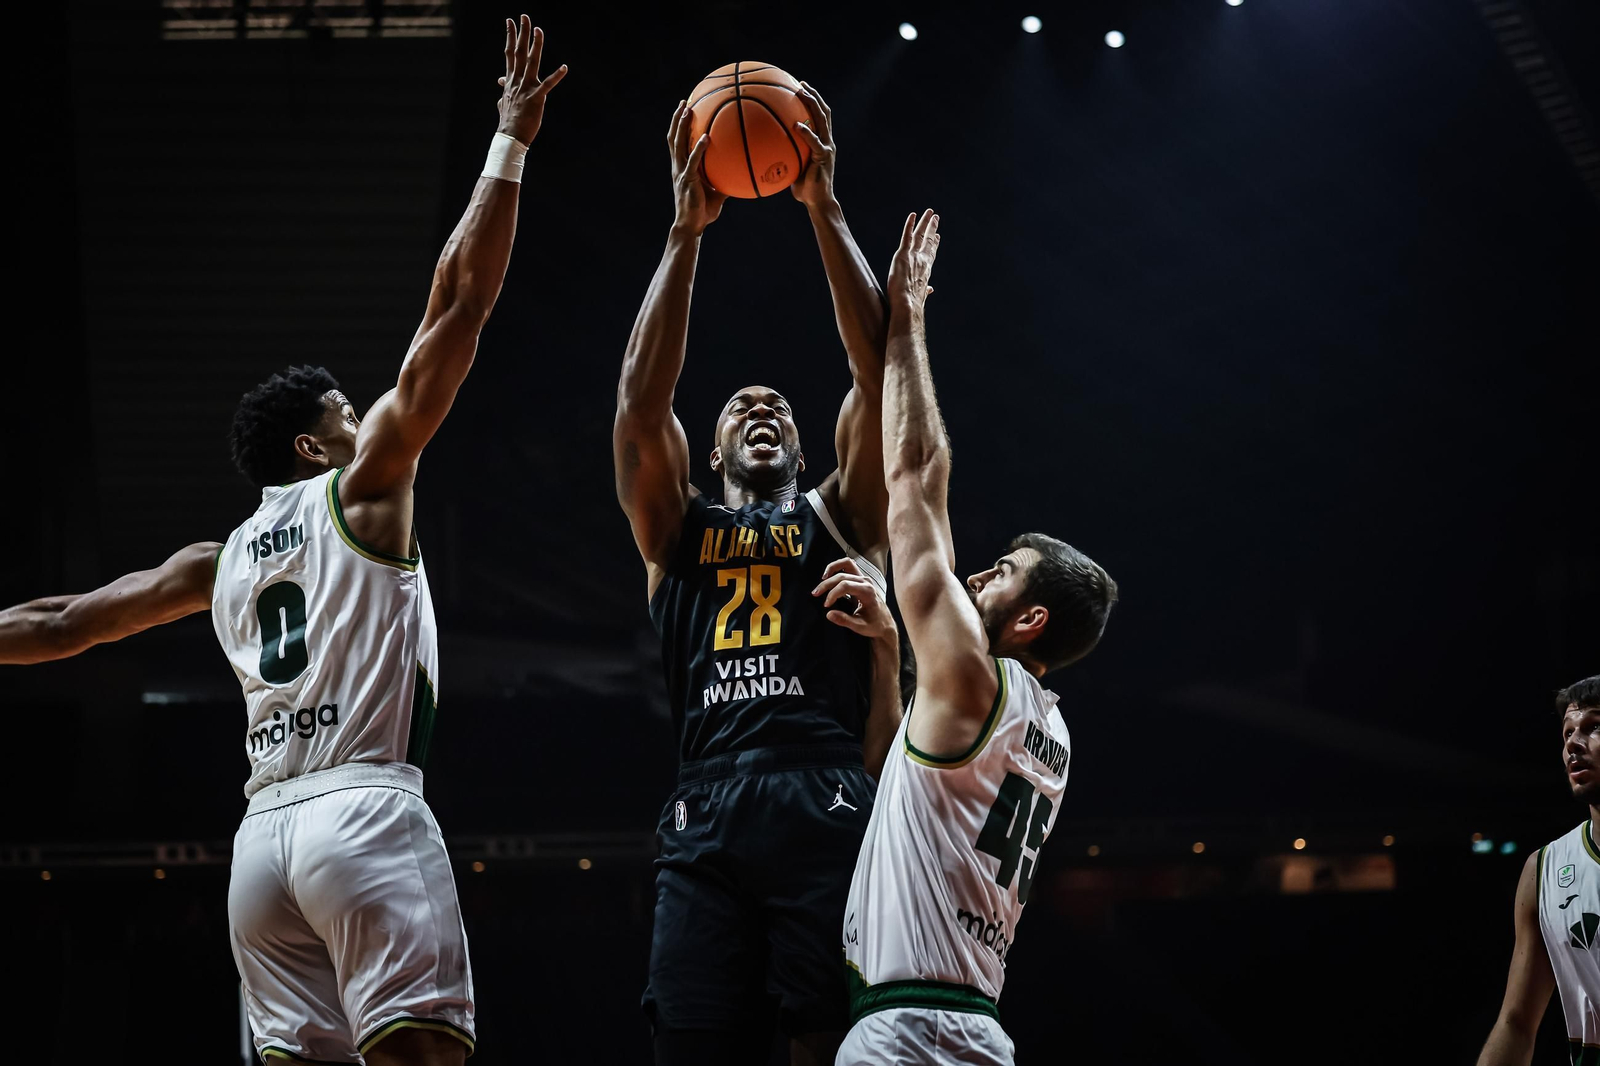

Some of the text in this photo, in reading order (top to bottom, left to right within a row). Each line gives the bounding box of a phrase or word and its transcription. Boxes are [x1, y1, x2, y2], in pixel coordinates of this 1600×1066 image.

[770, 524, 803, 558] SC
[255, 581, 309, 684] 0
[713, 565, 783, 652] 28
[703, 675, 805, 710] RWANDA
[715, 654, 779, 680] VISIT
[974, 771, 1054, 906] 45
